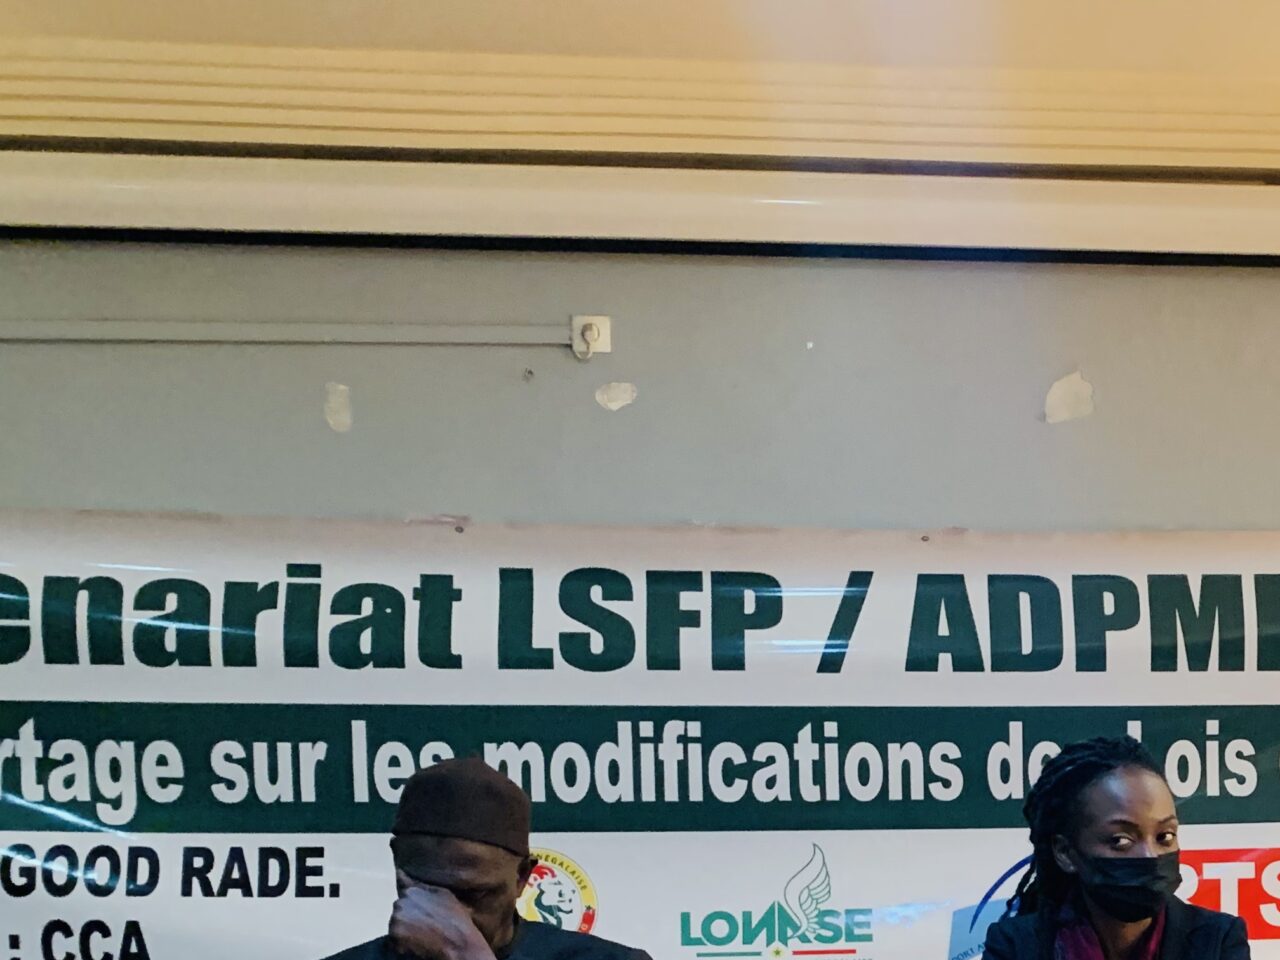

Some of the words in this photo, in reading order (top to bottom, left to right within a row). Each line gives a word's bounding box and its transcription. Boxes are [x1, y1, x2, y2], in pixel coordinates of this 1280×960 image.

[499, 567, 783, 673] LSFP
[816, 570, 874, 674] /
[210, 740, 327, 804] sur
[483, 720, 964, 803] modifications
[1127, 720, 1258, 798] ois
[0, 843, 160, 898] GOOD
[181, 846, 341, 899] RADE.
[680, 901, 874, 948] LONASE
